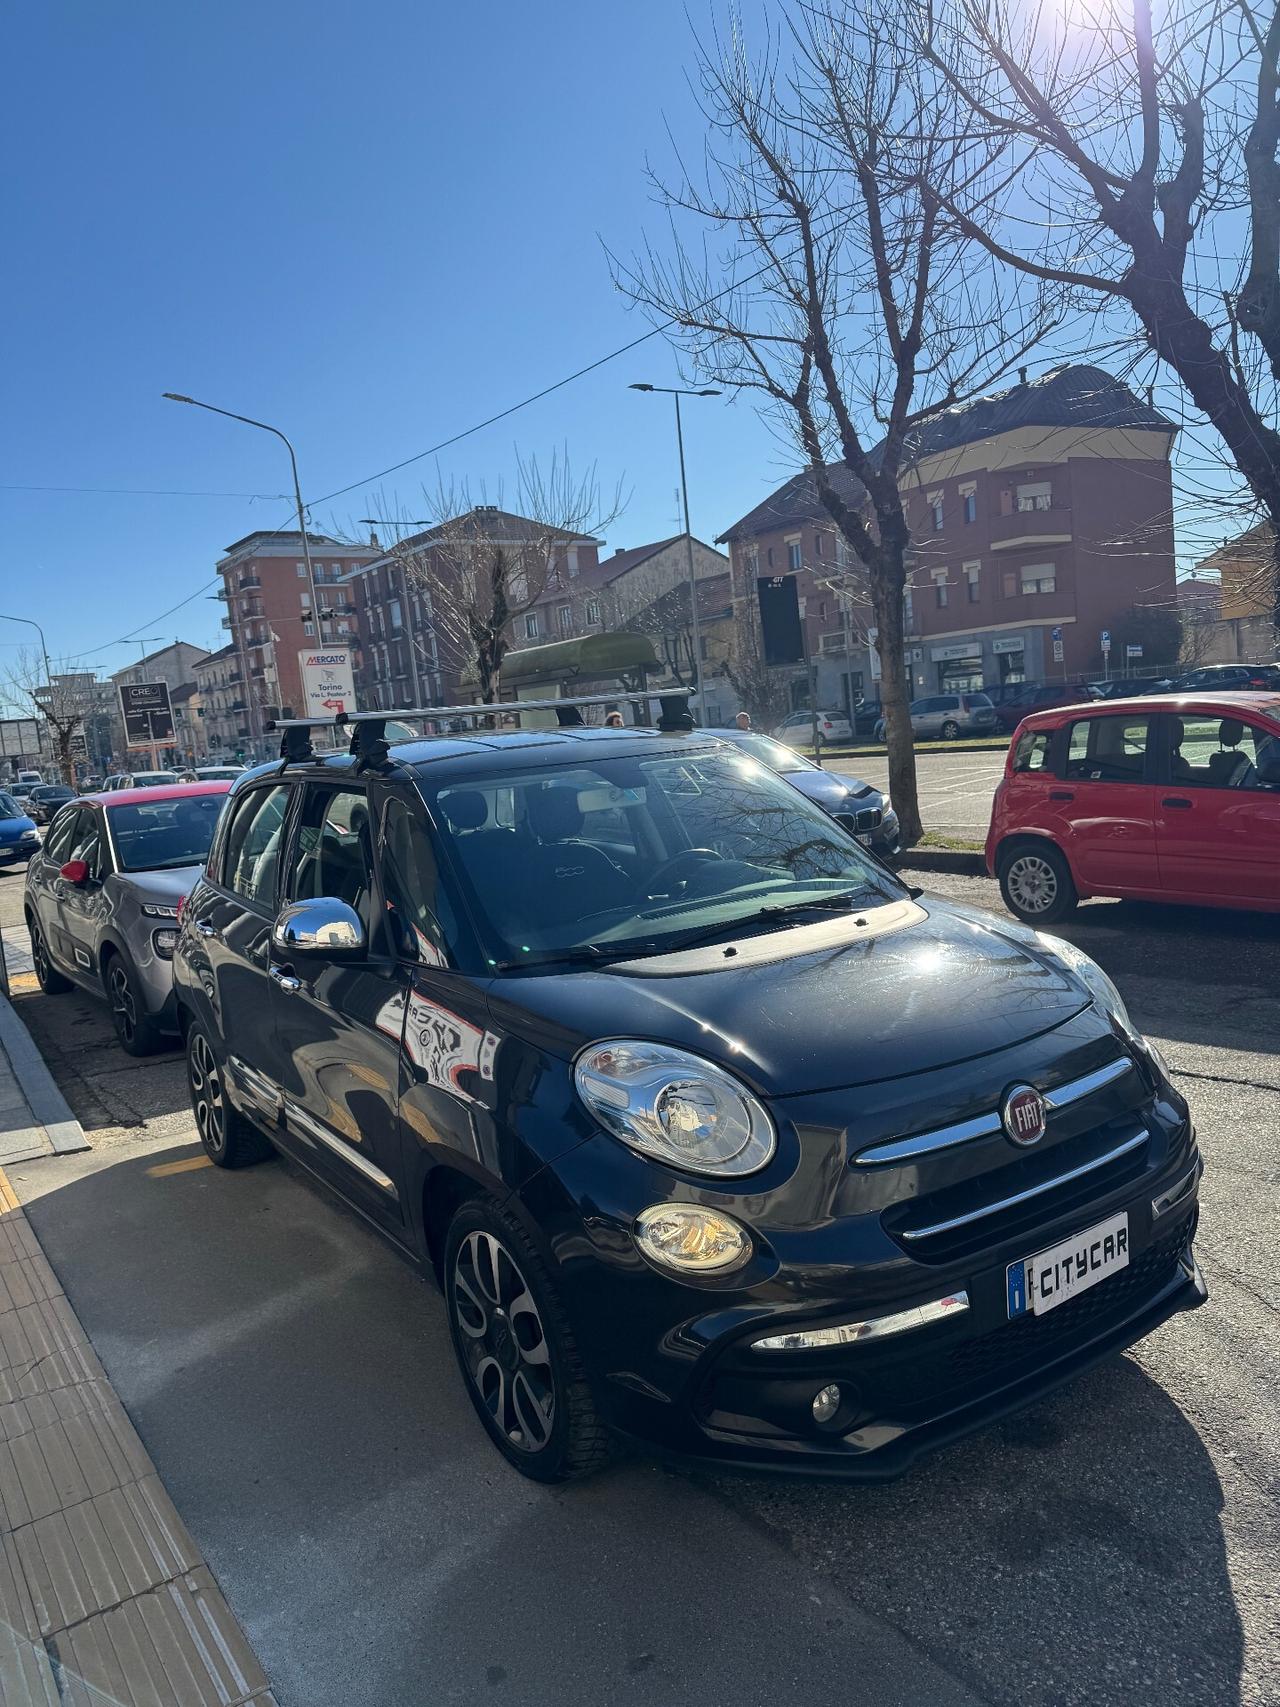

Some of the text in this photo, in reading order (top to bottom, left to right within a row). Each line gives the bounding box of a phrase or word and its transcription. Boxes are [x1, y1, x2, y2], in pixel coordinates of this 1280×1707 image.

[1102, 631, 1109, 640] P
[306, 655, 346, 666] MERCATO
[318, 683, 343, 691] Torino
[1014, 1101, 1041, 1133] FIAT
[1040, 1227, 1127, 1299] CITYCAR
